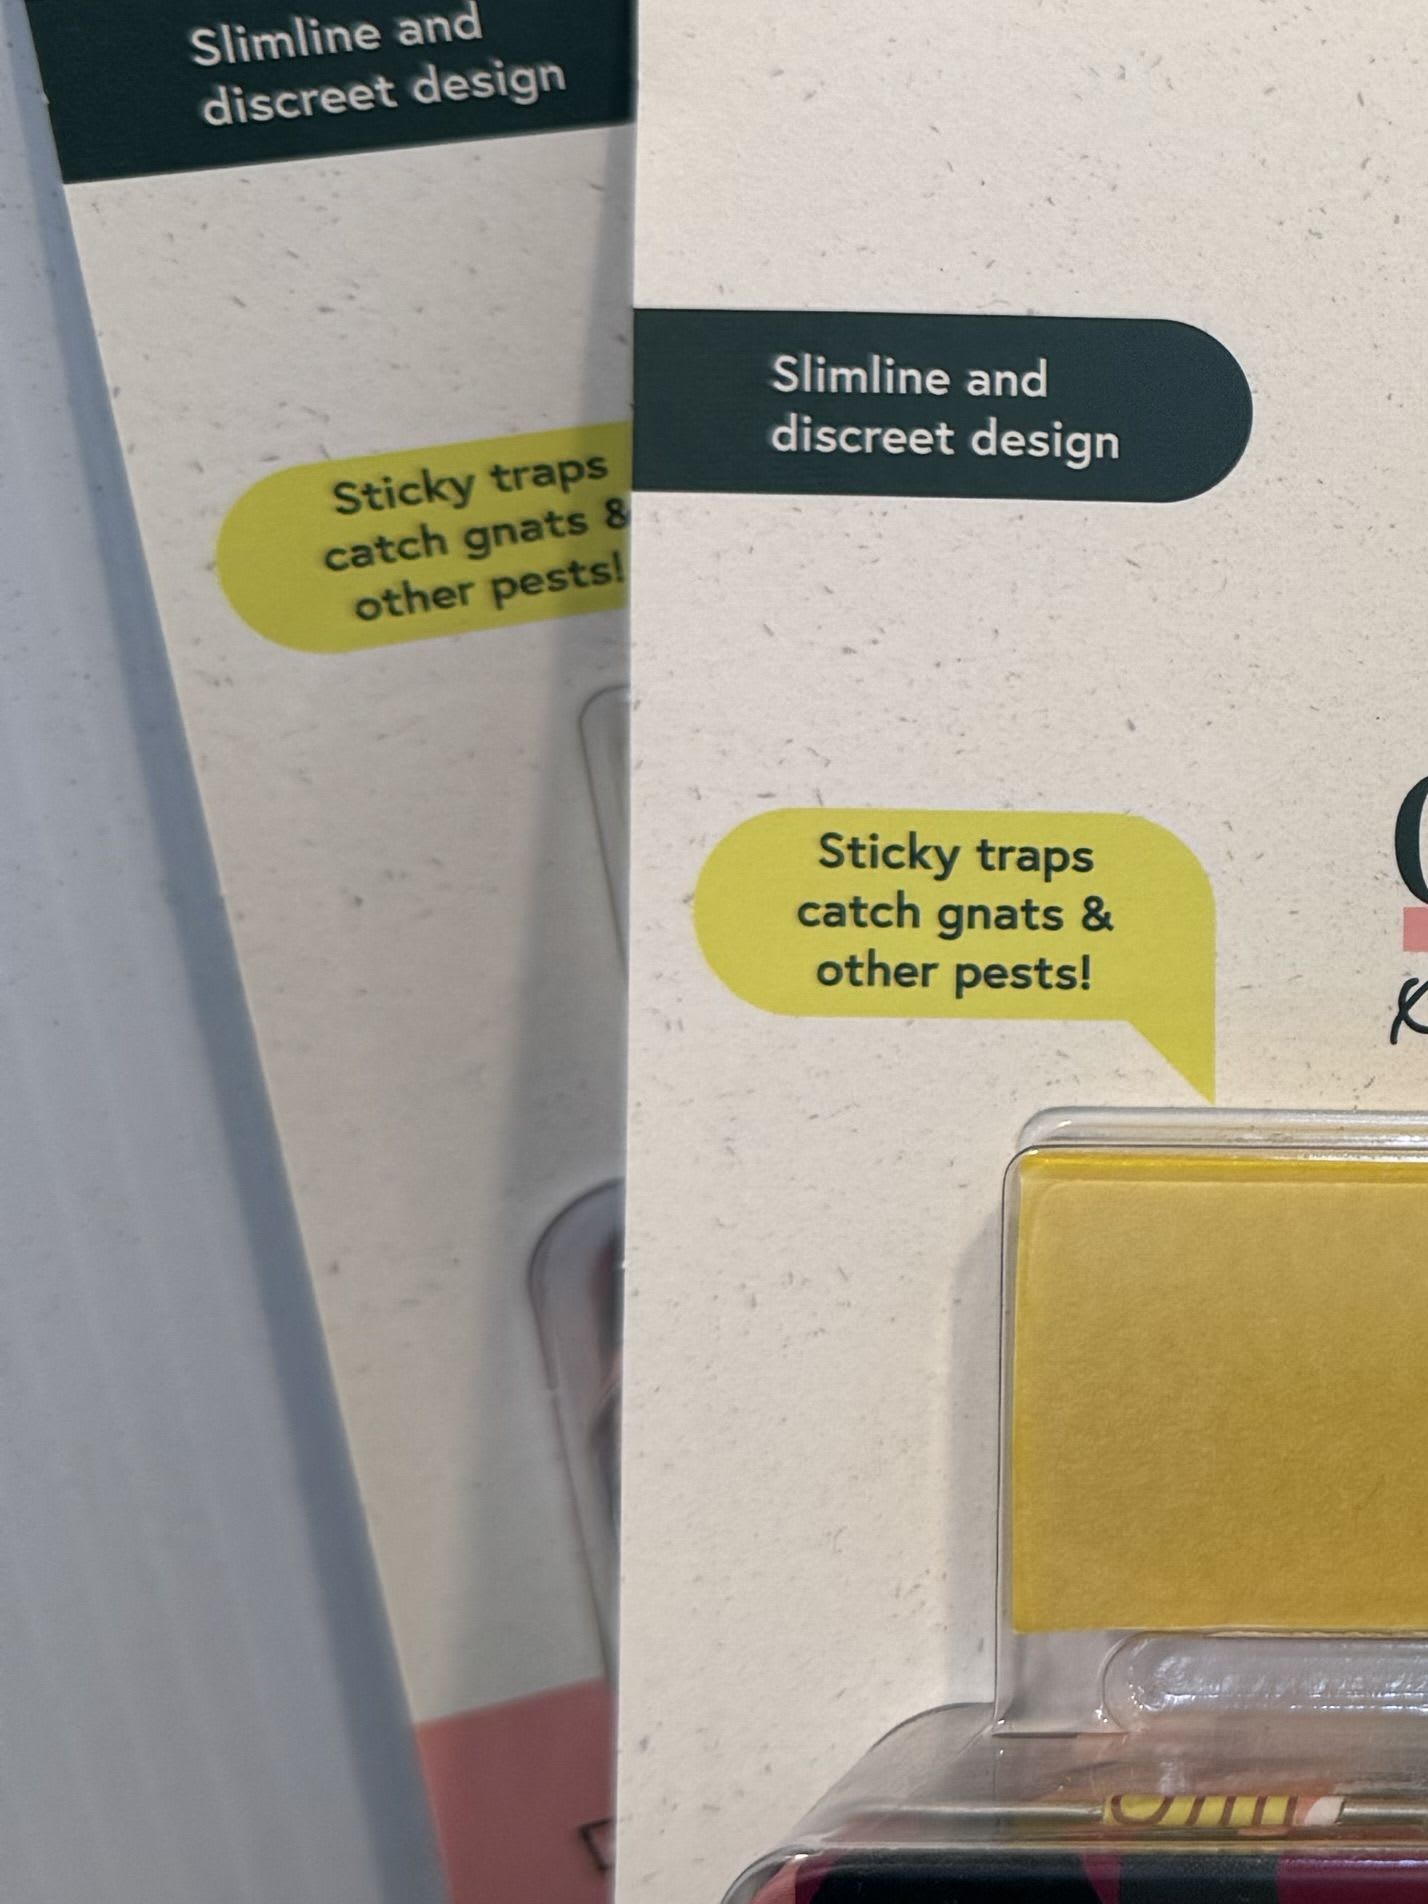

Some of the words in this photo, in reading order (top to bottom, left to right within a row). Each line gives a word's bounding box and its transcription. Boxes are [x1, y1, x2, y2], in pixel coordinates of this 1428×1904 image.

[190, 15, 381, 67] Slimline
[203, 75, 398, 126] discreet
[413, 58, 566, 105] design
[770, 354, 951, 398] Slimline
[966, 358, 1049, 398] and
[770, 413, 954, 456] discreet
[970, 417, 1120, 469] design
[333, 467, 475, 514] Sticky
[490, 456, 608, 493] traps
[324, 523, 448, 571] catch
[464, 510, 589, 560] gnats
[355, 580, 475, 621] other
[491, 551, 625, 610] pests!
[818, 831, 961, 880] Sticky
[976, 834, 1095, 881] traps
[797, 889, 921, 929] catch
[937, 897, 1065, 941] gnats
[1081, 897, 1115, 932] &
[816, 949, 939, 988] other
[954, 955, 1092, 998] pests!
